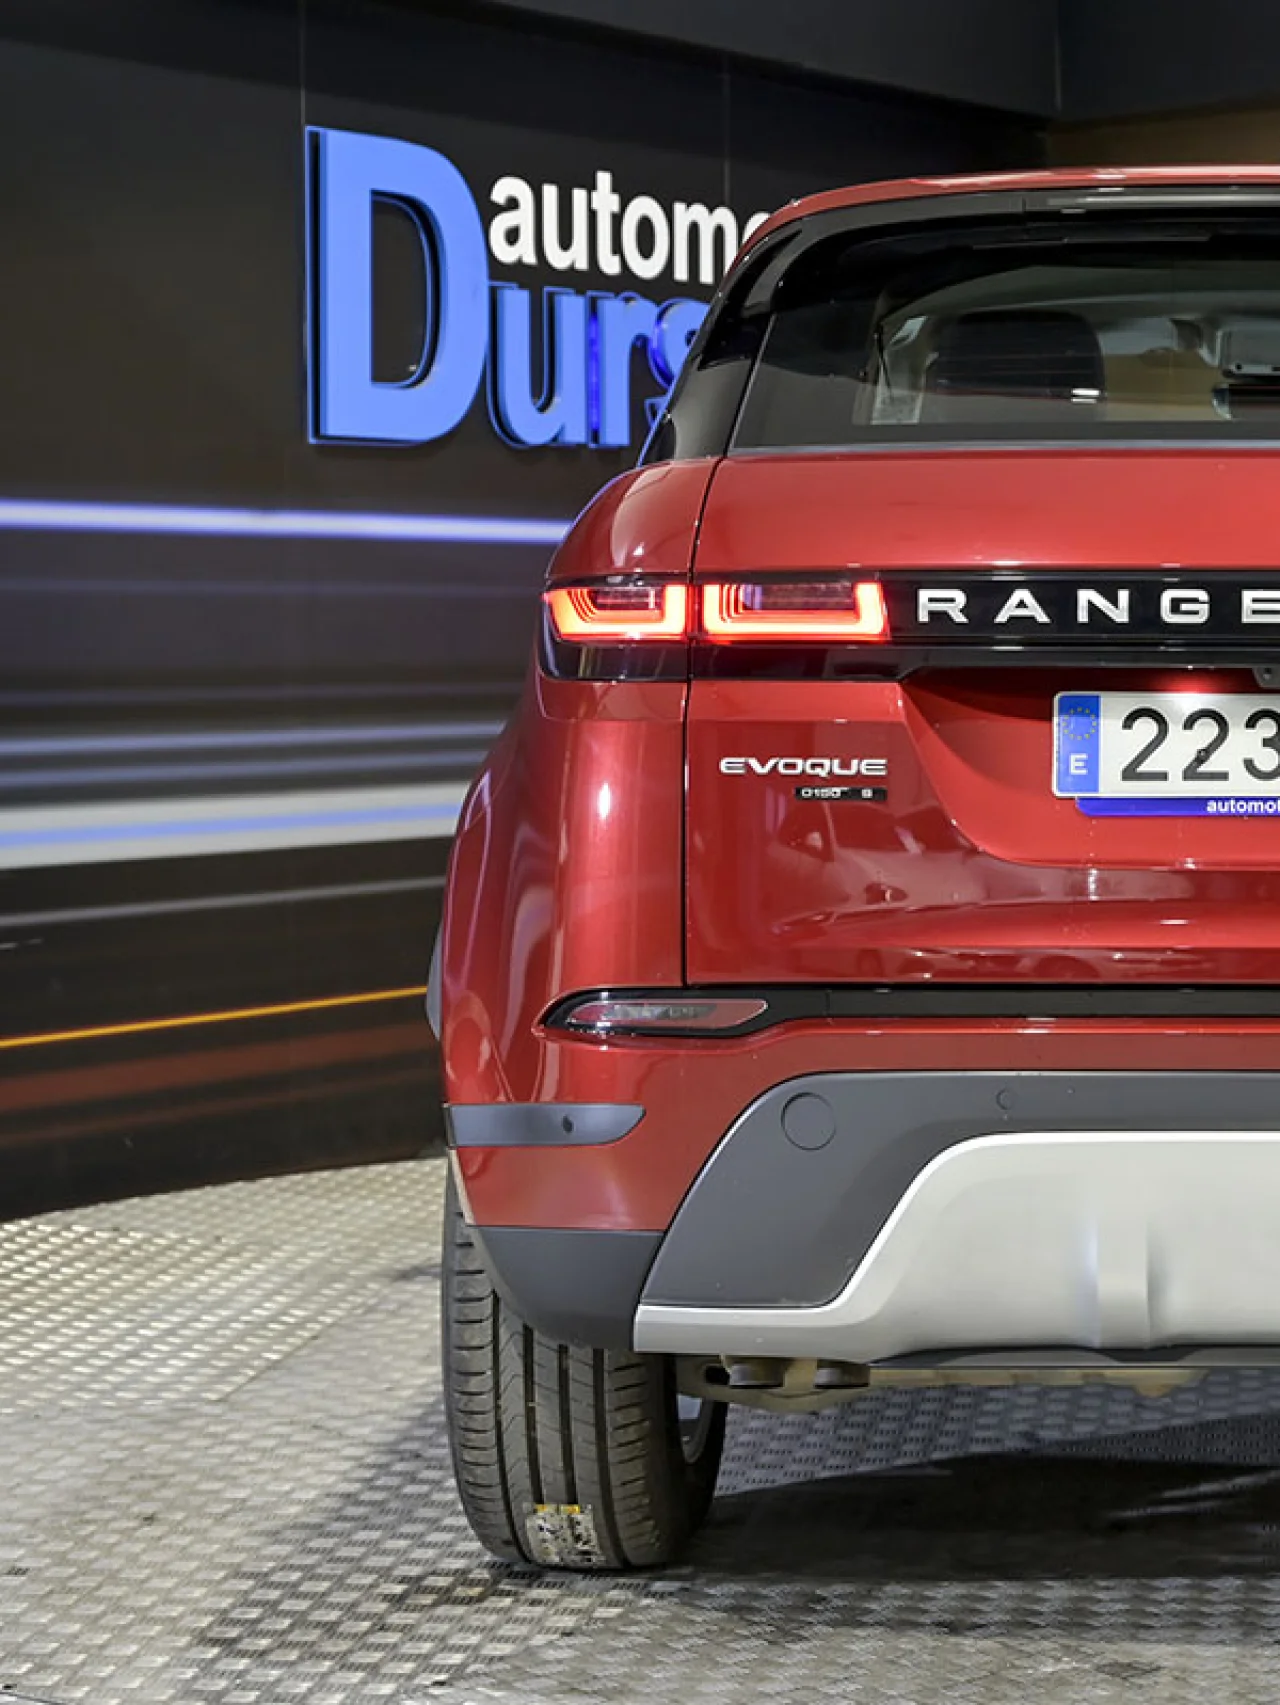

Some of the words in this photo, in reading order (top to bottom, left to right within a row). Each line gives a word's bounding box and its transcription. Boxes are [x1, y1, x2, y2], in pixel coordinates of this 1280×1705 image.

[489, 170, 772, 285] autom
[719, 757, 888, 777] EVOQUE
[1069, 752, 1088, 775] E
